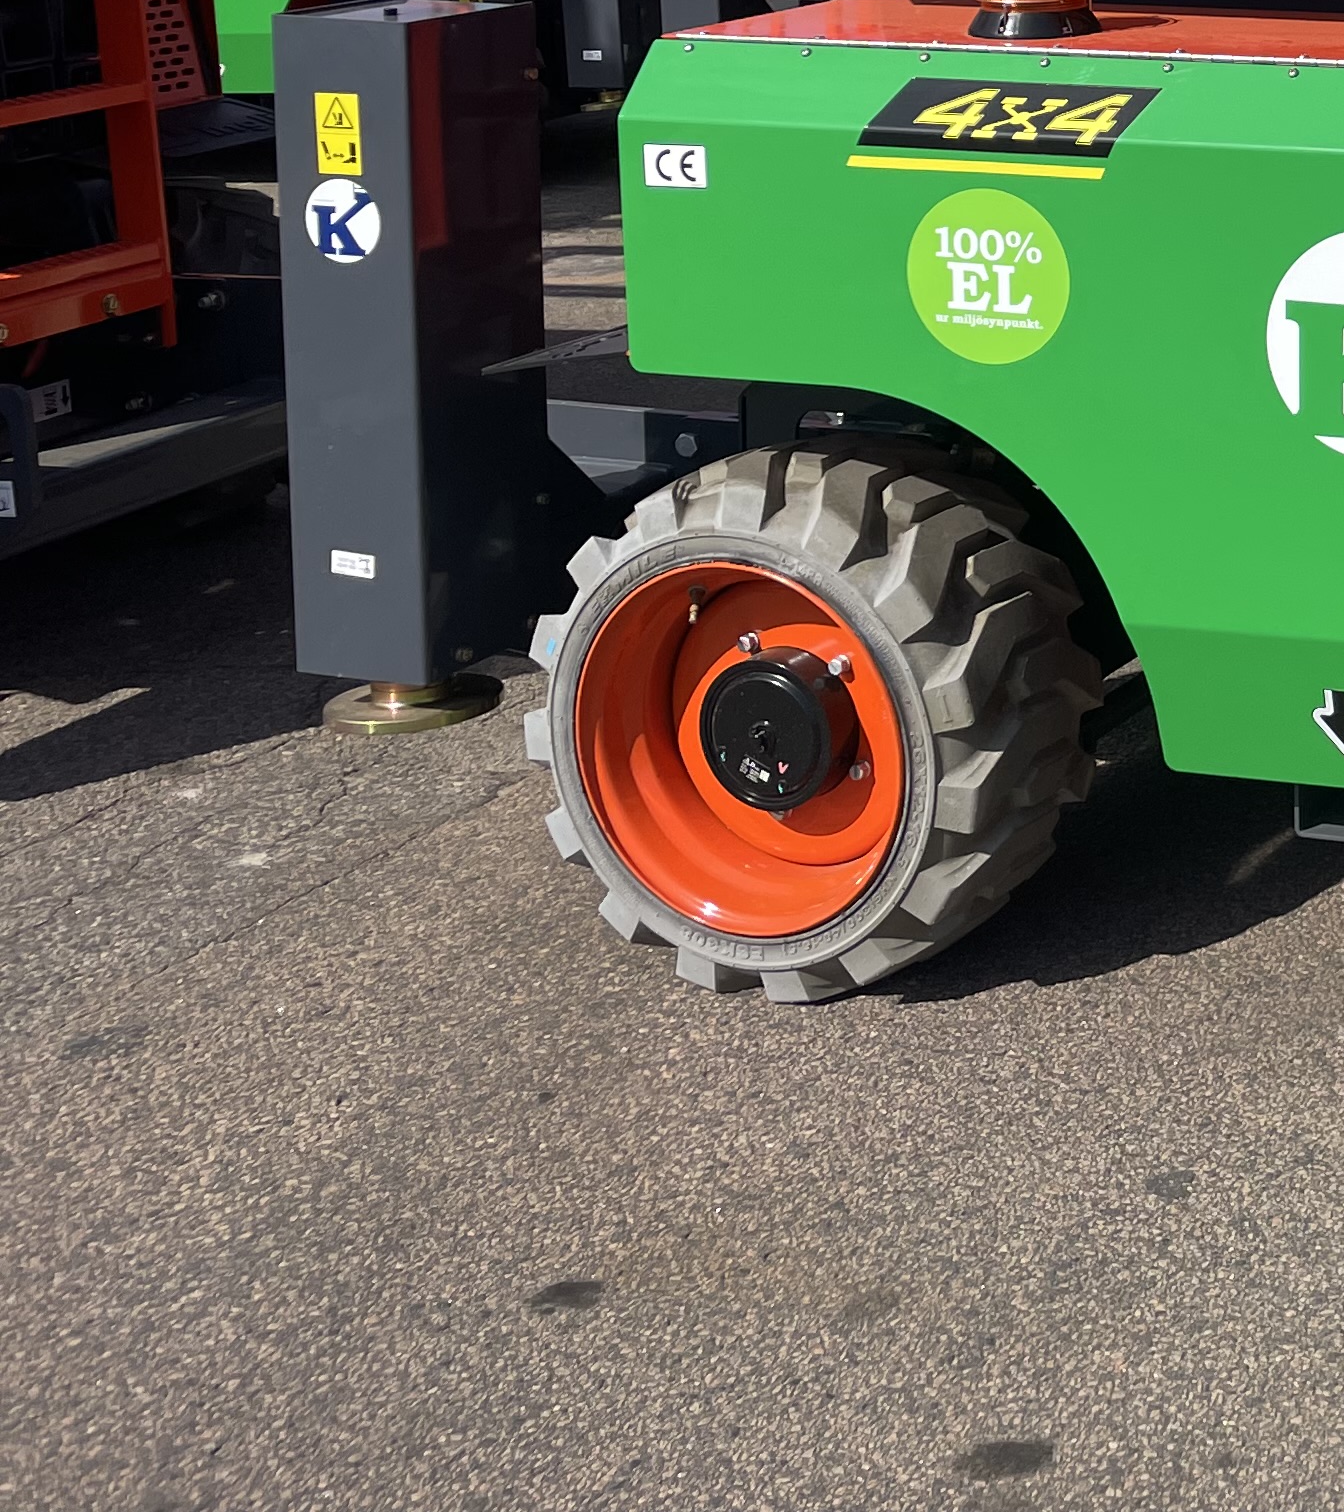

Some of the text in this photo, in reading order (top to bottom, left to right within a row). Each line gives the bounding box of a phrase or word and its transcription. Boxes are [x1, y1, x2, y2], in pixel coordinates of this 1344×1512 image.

[656, 148, 697, 182] CE
[934, 225, 1043, 265] 100%
[947, 261, 1033, 316] EL
[935, 311, 1044, 330] ur miljösynpunkt.
